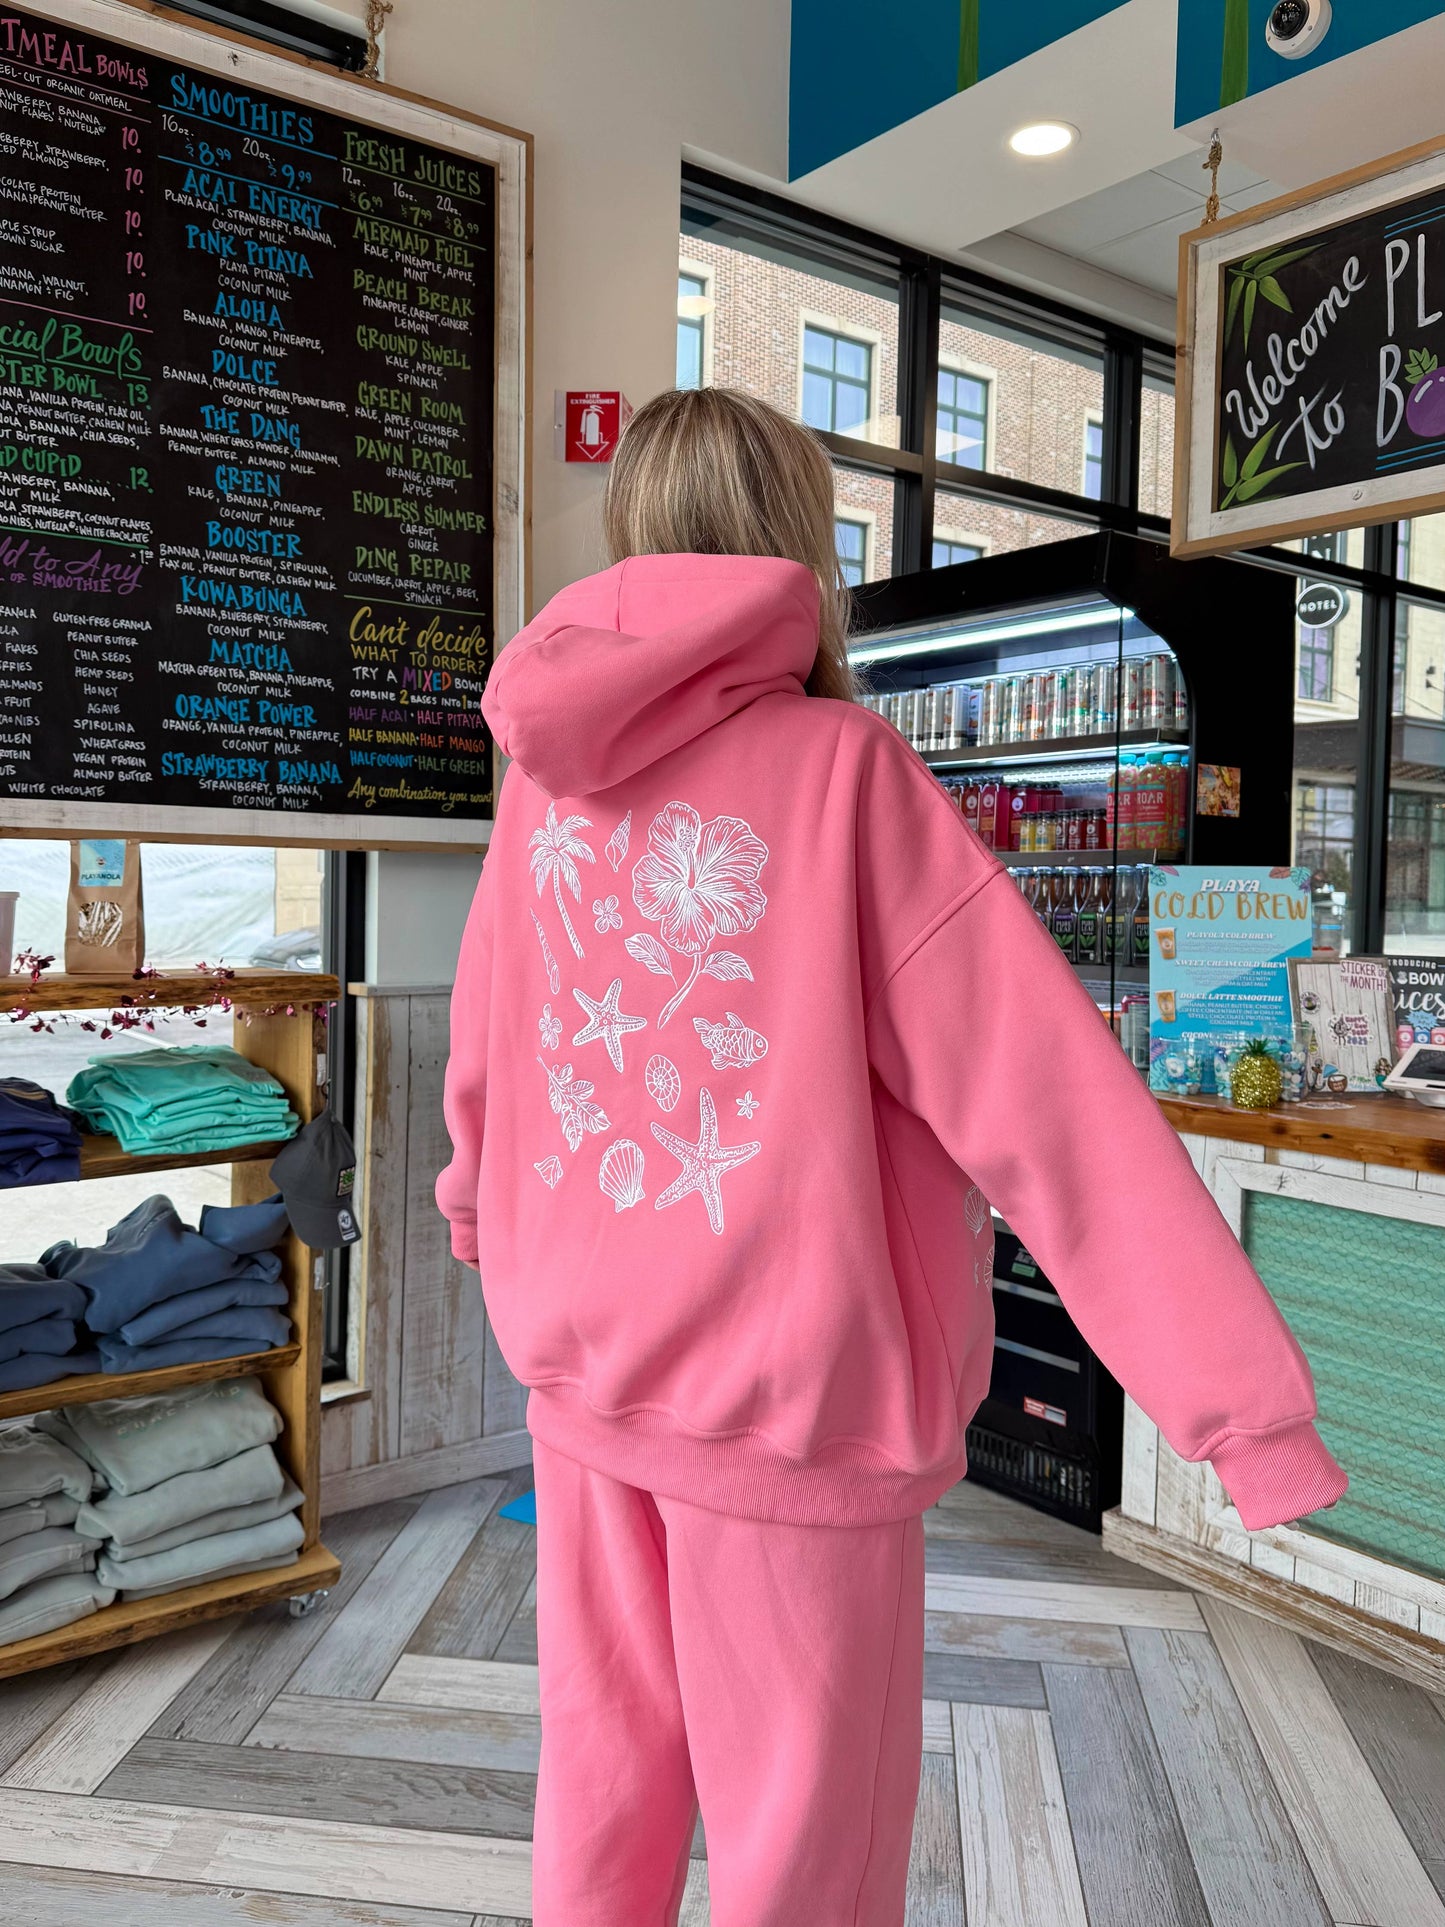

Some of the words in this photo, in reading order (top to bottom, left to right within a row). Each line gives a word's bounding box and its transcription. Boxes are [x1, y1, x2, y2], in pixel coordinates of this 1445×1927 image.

[96, 54, 148, 89] BOWLS
[47, 79, 85, 97] ORGANIC
[89, 92, 132, 111] OATMEAL
[170, 73, 314, 144] SMOOTHIES
[59, 106, 100, 125] BANANA
[22, 149, 69, 168] ALMONDS
[344, 132, 406, 173] FRESH
[414, 155, 481, 195] JUICES
[182, 168, 237, 205] ACAI
[248, 185, 322, 229] ENERGY
[185, 224, 237, 257] PINK
[244, 240, 313, 278] PITAYA
[352, 217, 429, 256] MERMAID
[435, 239, 474, 268] FUEL
[403, 267, 428, 282] MINT
[55, 289, 74, 300] FIG
[353, 269, 407, 301] BEACH
[417, 286, 475, 318] BREAK
[214, 292, 285, 331] ALOHA
[395, 317, 429, 335] LEMON
[56, 324, 142, 379] Bowls
[356, 325, 417, 357] GROUND
[422, 340, 471, 370] SWELL
[1226, 256, 1369, 438] Welcome
[52, 367, 103, 398] BOWL
[211, 350, 279, 385] DOLCE
[397, 373, 438, 389] SPINACH
[358, 381, 412, 413] GREEN
[420, 397, 466, 425] ROOM
[200, 405, 240, 434] THE
[250, 413, 300, 448] DANG
[1276, 380, 1346, 470] to
[355, 435, 403, 465] DAWN
[412, 448, 472, 478] PATROL
[418, 433, 448, 449] LEMON
[22, 446, 82, 477] CUPID
[215, 465, 281, 497] GREEN
[402, 484, 433, 498] APPLE
[353, 490, 420, 524] ENDLESS
[425, 504, 486, 534] SUMMER
[206, 521, 303, 558] BOOSTER
[408, 538, 439, 552] GINGER
[29, 546, 61, 571] to
[65, 549, 143, 595] Any
[356, 546, 399, 575] DING
[409, 554, 471, 583] REPAIR
[11, 573, 27, 583] OR
[33, 572, 112, 592] SMOOTHIE
[180, 575, 307, 618] KOWABUNGA
[1300, 599, 1337, 613] HOTEL
[67, 631, 102, 643] PEANUT
[105, 635, 138, 646] BUTTER
[113, 618, 152, 631] GRANOLA
[350, 606, 410, 646] Can't
[417, 616, 488, 657] decide
[74, 650, 99, 661] CHIA
[102, 652, 131, 663] SEEDS
[209, 639, 294, 672] MATCHA
[350, 644, 398, 663] WHAT
[409, 652, 427, 667] TO
[432, 656, 486, 675] ORDER?
[75, 667, 103, 678] HEMP
[105, 669, 134, 682] SEEDS
[352, 666, 378, 680] TRY
[386, 670, 397, 683] A
[402, 667, 452, 691] MIXED
[84, 683, 119, 698] HONEY
[350, 689, 396, 701] COMBINE
[400, 689, 409, 705] 2
[410, 695, 437, 705] BASES
[441, 698, 461, 707] INTO
[87, 703, 120, 714] AGAVE
[176, 694, 250, 724] ORANGE
[257, 700, 317, 728] POWER
[349, 707, 377, 721] HALF
[381, 709, 407, 722] ACAI
[417, 710, 443, 725] HALF
[448, 714, 483, 728] PITAYA
[349, 728, 373, 742] HALF
[376, 731, 417, 745] BANANA
[420, 734, 444, 748] HALF
[450, 736, 485, 752] MANGO
[73, 753, 105, 764] VEGAN
[111, 755, 146, 767] PROTEIN
[73, 769, 114, 780] ALMOND
[118, 771, 153, 782] BUTTER
[162, 751, 269, 782] STRAWBERRY
[278, 760, 343, 784] BANANA
[350, 750, 377, 765] HALF
[377, 753, 414, 768] COCONUT
[418, 756, 447, 772] HALF
[450, 758, 485, 775] GREEN
[8, 783, 46, 793] WHITE
[51, 785, 105, 797] CHOCOLATE
[232, 795, 276, 808] COCONUT
[282, 798, 309, 809] MILK
[348, 777, 377, 807] Any
[378, 778, 447, 800] combination
[442, 792, 468, 811] you
[1200, 879, 1260, 893] PLAYA
[1154, 891, 1225, 921] COLD
[1236, 892, 1309, 921] BREW
[1341, 961, 1376, 977] STICKER
[1350, 977, 1387, 993] MONTH!
